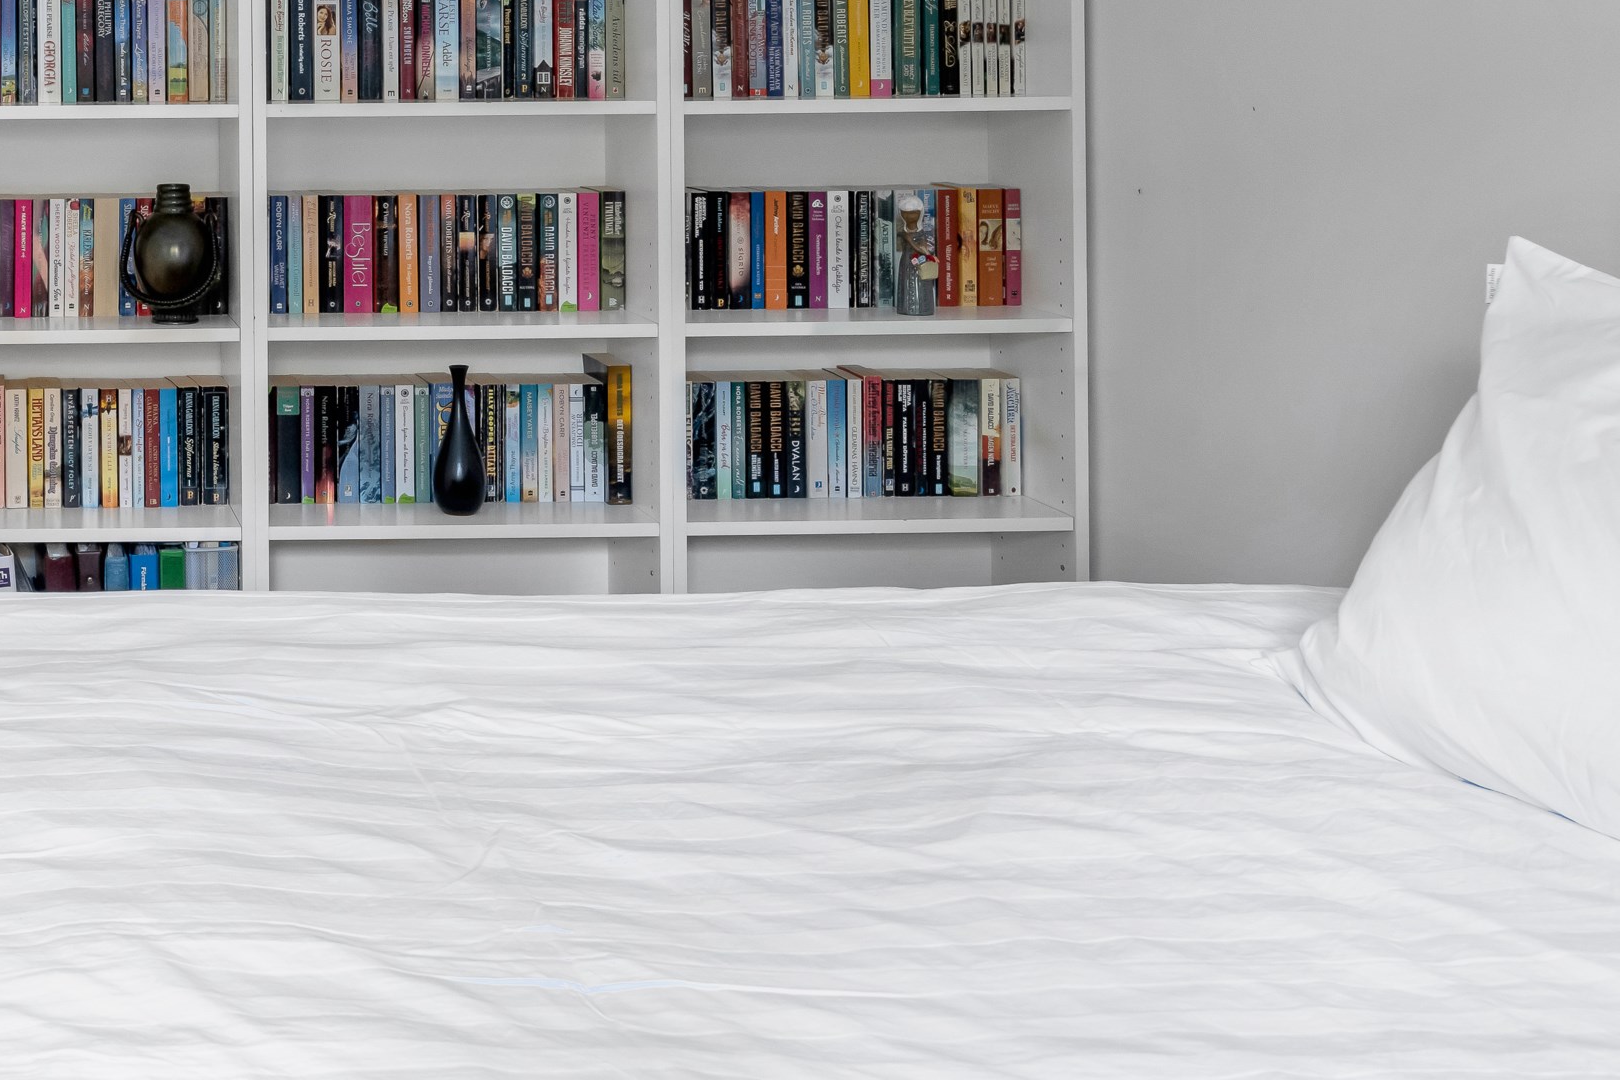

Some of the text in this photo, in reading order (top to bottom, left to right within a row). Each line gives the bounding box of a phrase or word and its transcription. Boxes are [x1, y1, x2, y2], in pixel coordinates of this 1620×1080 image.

[97, 0, 105, 38] GREGORY
[362, 1, 378, 34] Belle
[802, 9, 812, 45] ROBERTS
[837, 9, 846, 44] ROBERTS
[44, 41, 56, 86] GEORGIA
[321, 39, 331, 83] ROSIE
[560, 27, 572, 86] JOHANNA KINGSLEY
[405, 203, 413, 260] Nora Roberts
[522, 225, 533, 266] BALDACCI
[793, 222, 804, 263] BALDACCI
[501, 227, 513, 294] DAVID BALDACCI
[32, 398, 43, 461] HETTANS LAND
[770, 411, 781, 452] BALDACCI
[792, 440, 800, 481] DVALAN
